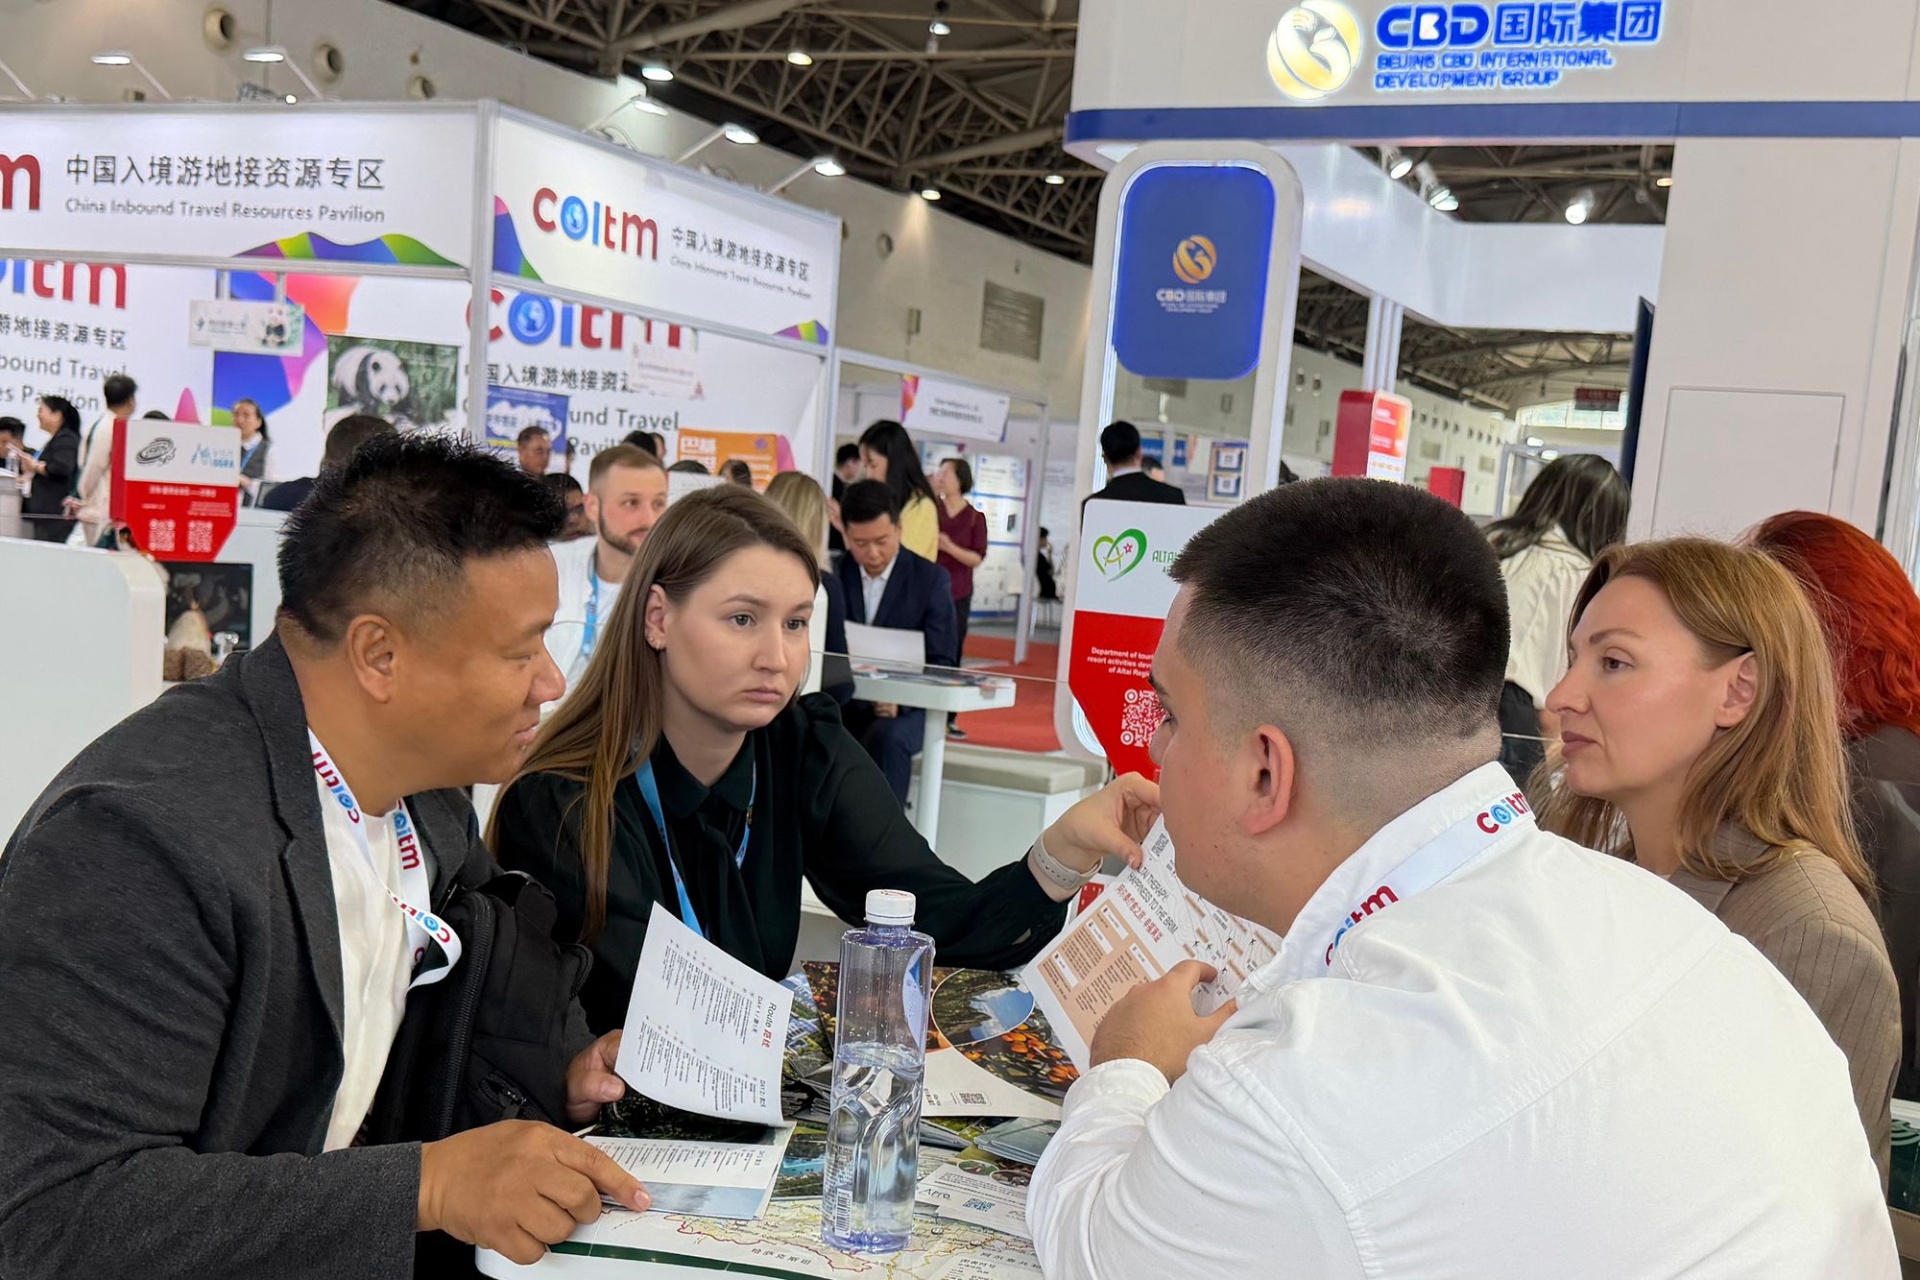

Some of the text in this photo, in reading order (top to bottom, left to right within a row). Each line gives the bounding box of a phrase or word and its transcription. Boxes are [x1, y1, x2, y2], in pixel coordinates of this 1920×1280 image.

[1441, 52, 1474, 69] CBD
[1480, 50, 1613, 69] INTERNATIONAL
[1375, 70, 1560, 90] DEVELOPMENT GROUP
[66, 154, 386, 190] 中国入境游地接资源专区
[65, 197, 386, 224] China Inbound Travel Resources Pavilion
[615, 407, 679, 431] Travel
[1087, 656, 1107, 665] resort
[1107, 658, 1137, 668] activities
[1091, 646, 1129, 659] Department
[1130, 651, 1138, 659] of
[1108, 666, 1117, 674] of
[1116, 667, 1132, 676] Altai
[1127, 871, 1179, 936] HAPPINESS TO THE BRIM
[765, 1002, 777, 1028] Route
